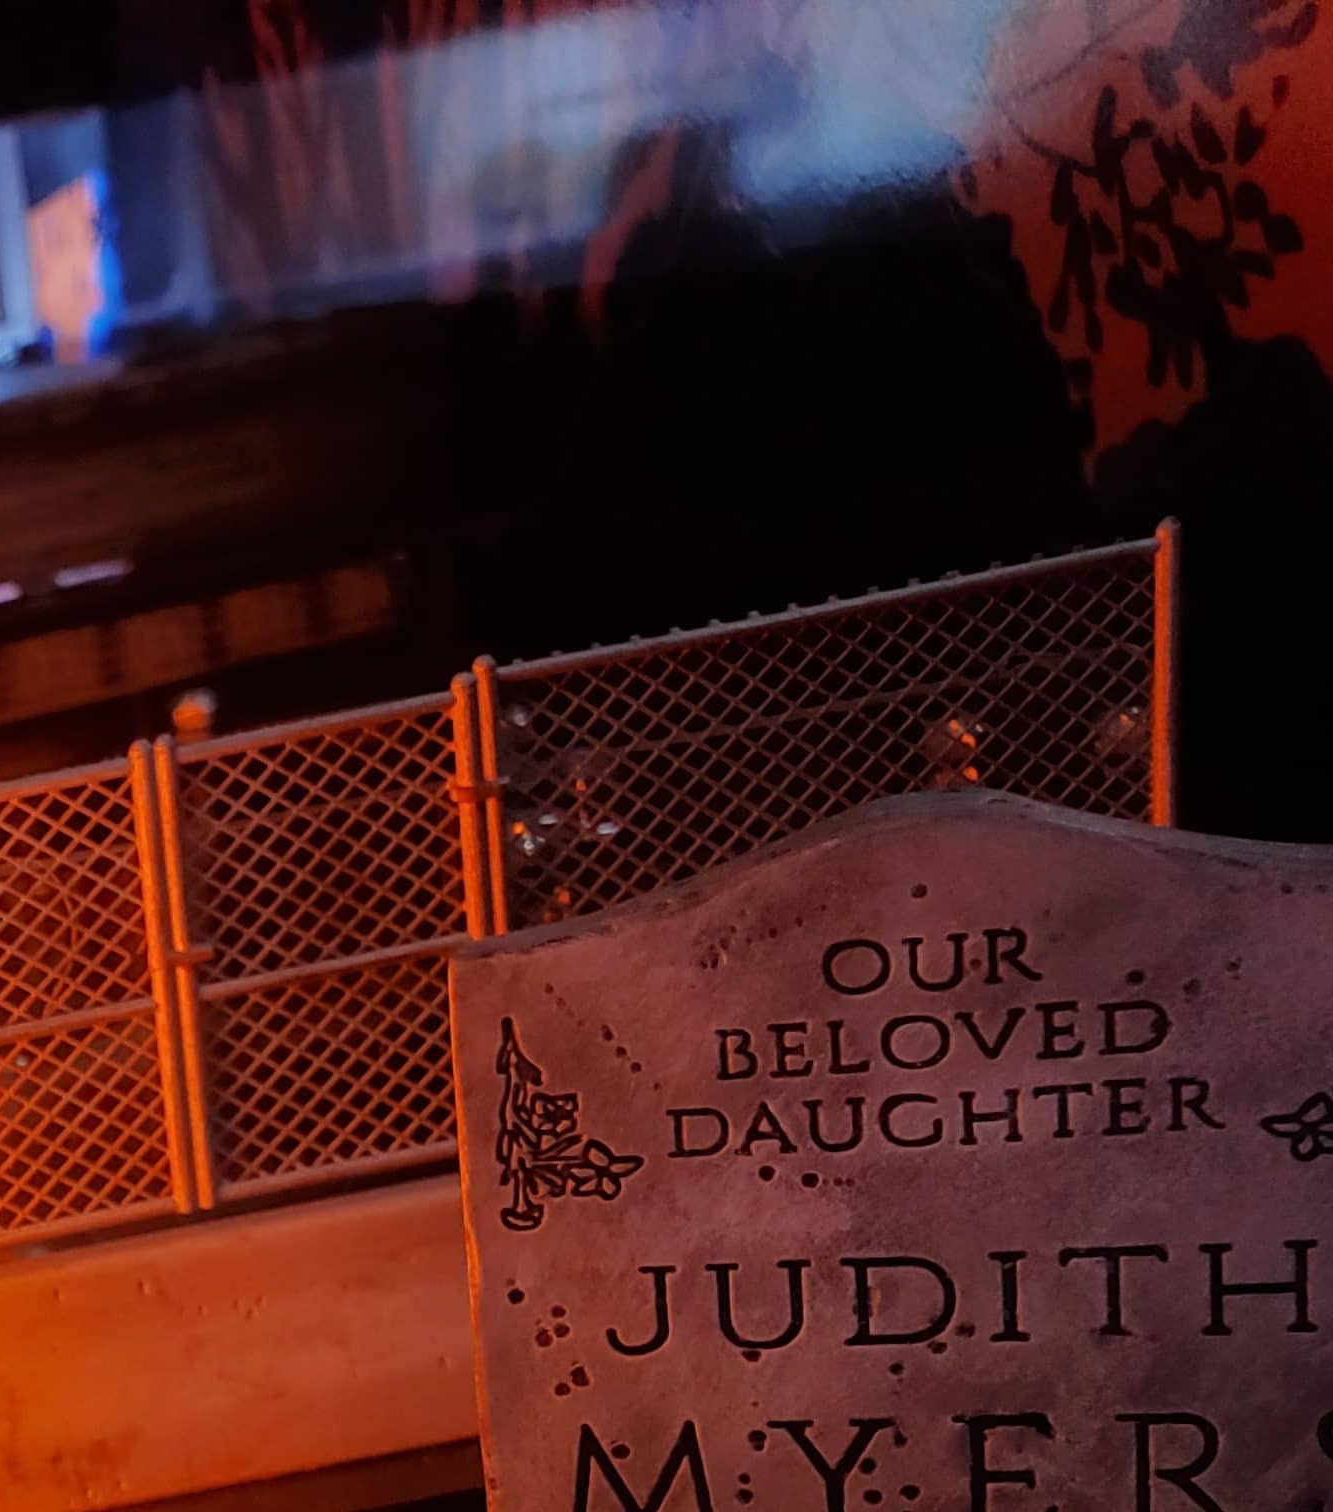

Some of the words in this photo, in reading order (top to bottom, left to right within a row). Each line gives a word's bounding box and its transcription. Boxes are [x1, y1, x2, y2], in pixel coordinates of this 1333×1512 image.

[821, 928, 1041, 996] OUR
[715, 1000, 1170, 1081] BELOVED
[666, 1078, 1225, 1159] DAUGHTER
[606, 1240, 1318, 1356] JUDITH
